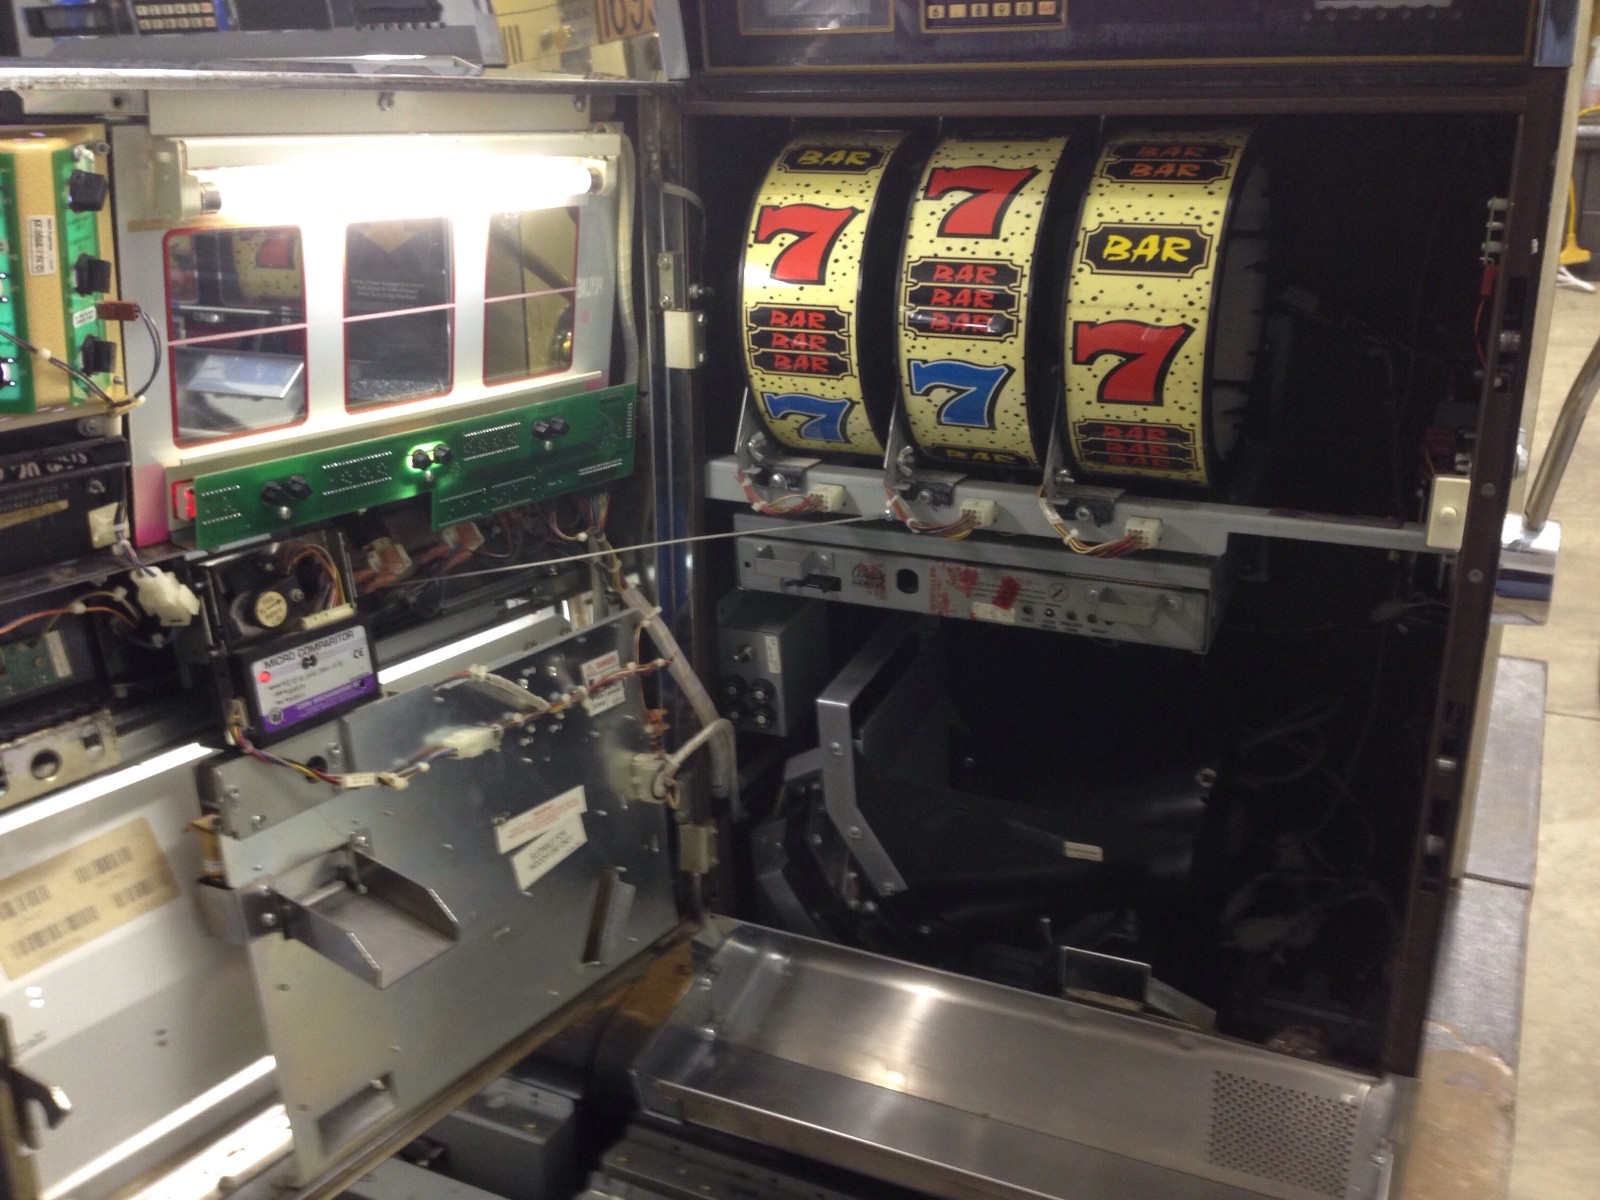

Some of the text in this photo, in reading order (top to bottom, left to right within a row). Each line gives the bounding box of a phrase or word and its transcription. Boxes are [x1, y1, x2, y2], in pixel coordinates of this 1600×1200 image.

[797, 150, 871, 166] BAR
[1130, 163, 1201, 177] BAR
[922, 166, 1042, 239] 7
[753, 203, 865, 285] 7
[1103, 234, 1192, 263] BAR
[932, 264, 997, 284] BAR
[931, 288, 995, 308] BAR
[769, 309, 828, 329] BAR
[929, 311, 990, 333] BAR
[771, 332, 828, 351] BAR
[773, 353, 830, 372] BAR
[1072, 319, 1196, 407] 7
[907, 359, 1017, 430] 7
[760, 391, 860, 443] 7
[1102, 424, 1169, 441] BAR
[1105, 441, 1170, 457] BAR
[263, 630, 355, 669] MICRO COMPARITOR
